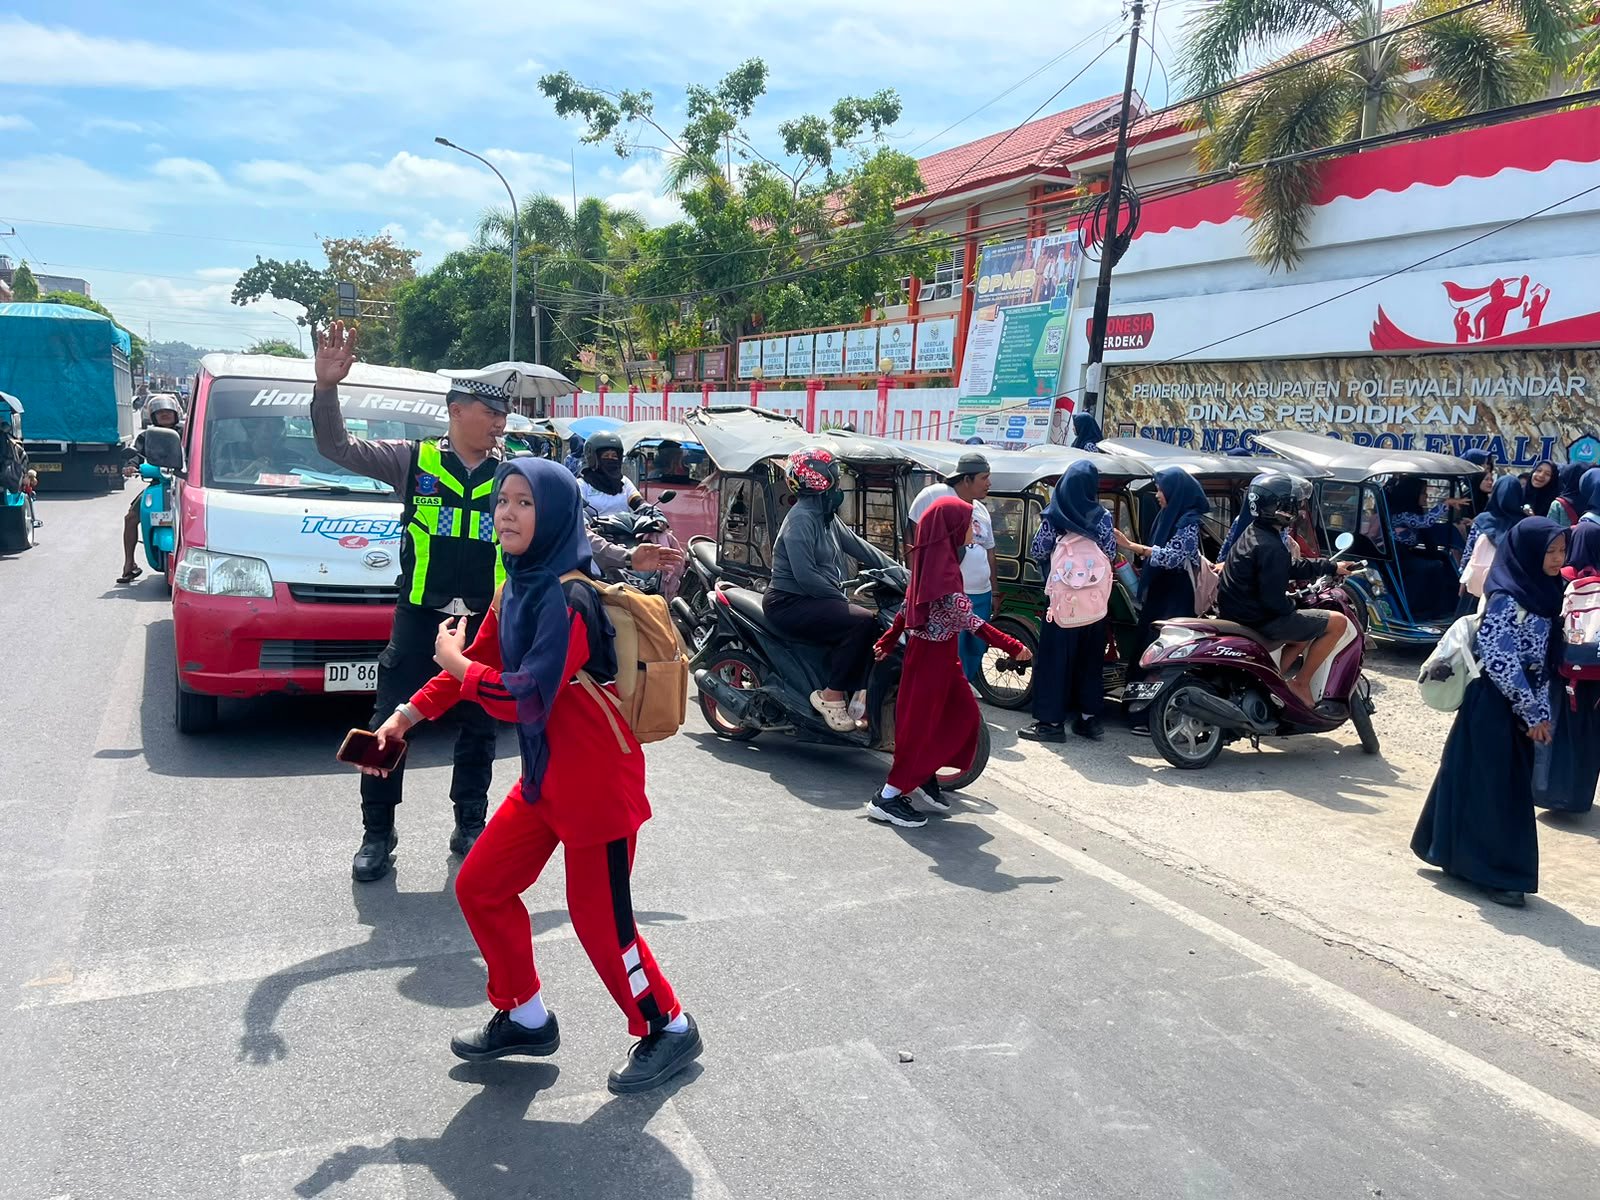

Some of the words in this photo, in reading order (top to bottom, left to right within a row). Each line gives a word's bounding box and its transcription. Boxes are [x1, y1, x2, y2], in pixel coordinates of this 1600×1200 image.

[978, 269, 1036, 294] SPMB
[1103, 335, 1143, 348] ERDEKA
[1132, 383, 1226, 398] PEMERINTAH
[1231, 380, 1341, 398] KABUPATEN
[1347, 377, 1463, 398] POLEWALI
[1470, 376, 1586, 398] MANDAR
[250, 389, 349, 407] Hona
[359, 393, 450, 423] Racing
[1188, 404, 1265, 422] DINAS
[1276, 404, 1477, 425] PENDIDIKAN
[1139, 426, 1194, 449] SMP
[1208, 645, 1247, 657] Fino
[328, 666, 349, 681] DD
[357, 665, 376, 680] 86
